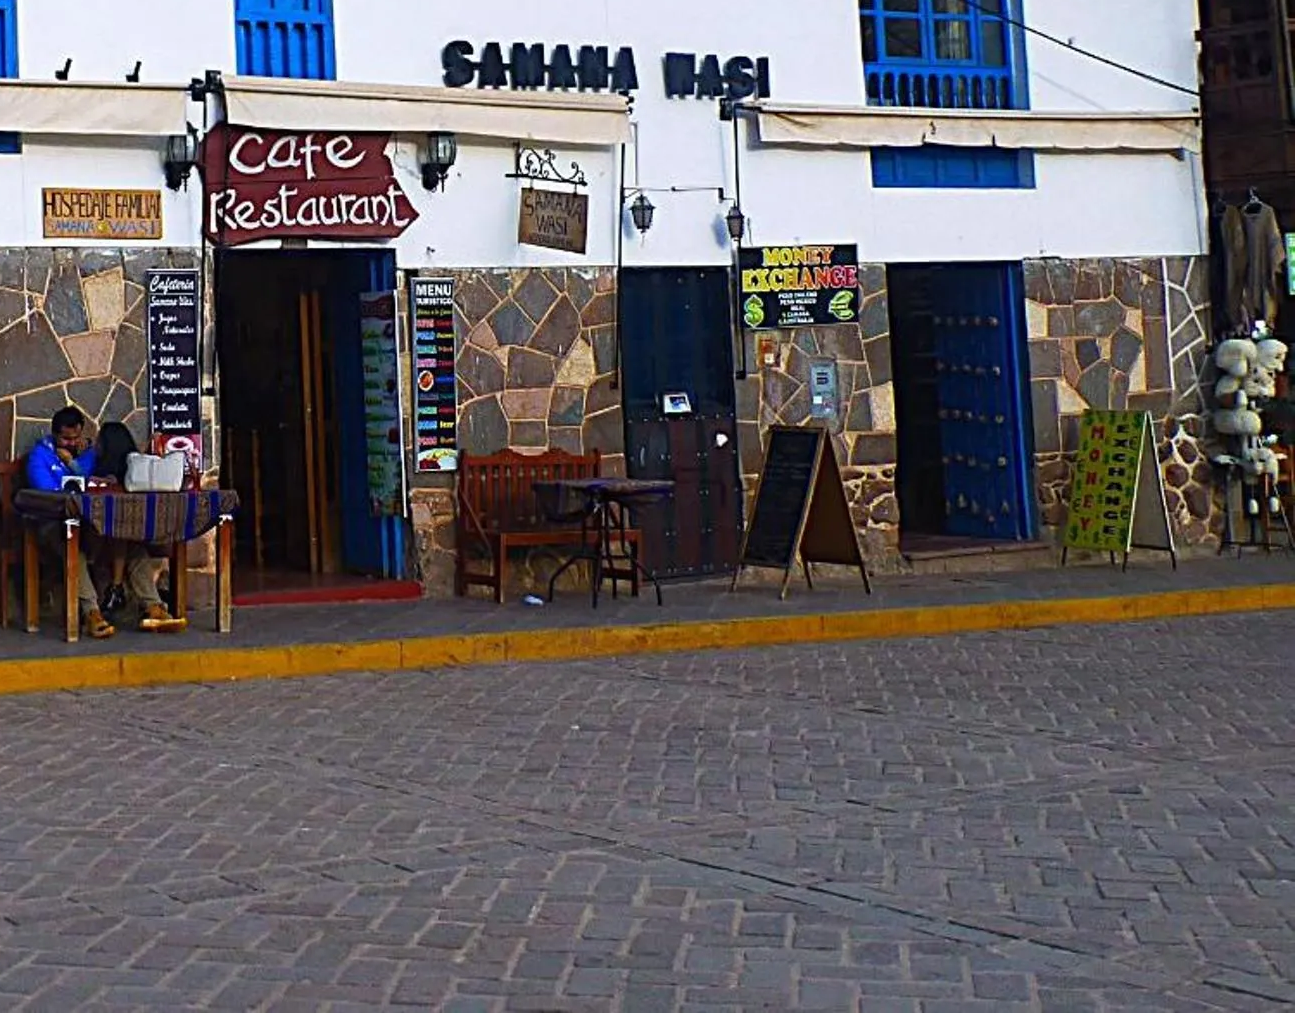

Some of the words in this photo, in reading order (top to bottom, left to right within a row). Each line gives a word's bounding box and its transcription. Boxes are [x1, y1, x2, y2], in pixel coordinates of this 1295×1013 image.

[442, 40, 639, 92] SAMANA
[662, 52, 770, 100] WASI
[229, 133, 366, 179] Cafe
[45, 192, 112, 220] HOSPEDAJE
[210, 184, 409, 233] Restaurant
[524, 192, 582, 224] SAMANA
[109, 220, 159, 235] WASI
[536, 214, 567, 235] WASI
[762, 246, 834, 266] MONEY
[416, 284, 451, 296] MENU
[742, 265, 857, 292] EXCHANGE
[1080, 425, 1105, 531] MONEY
[1102, 424, 1129, 536] EXCHANGE
